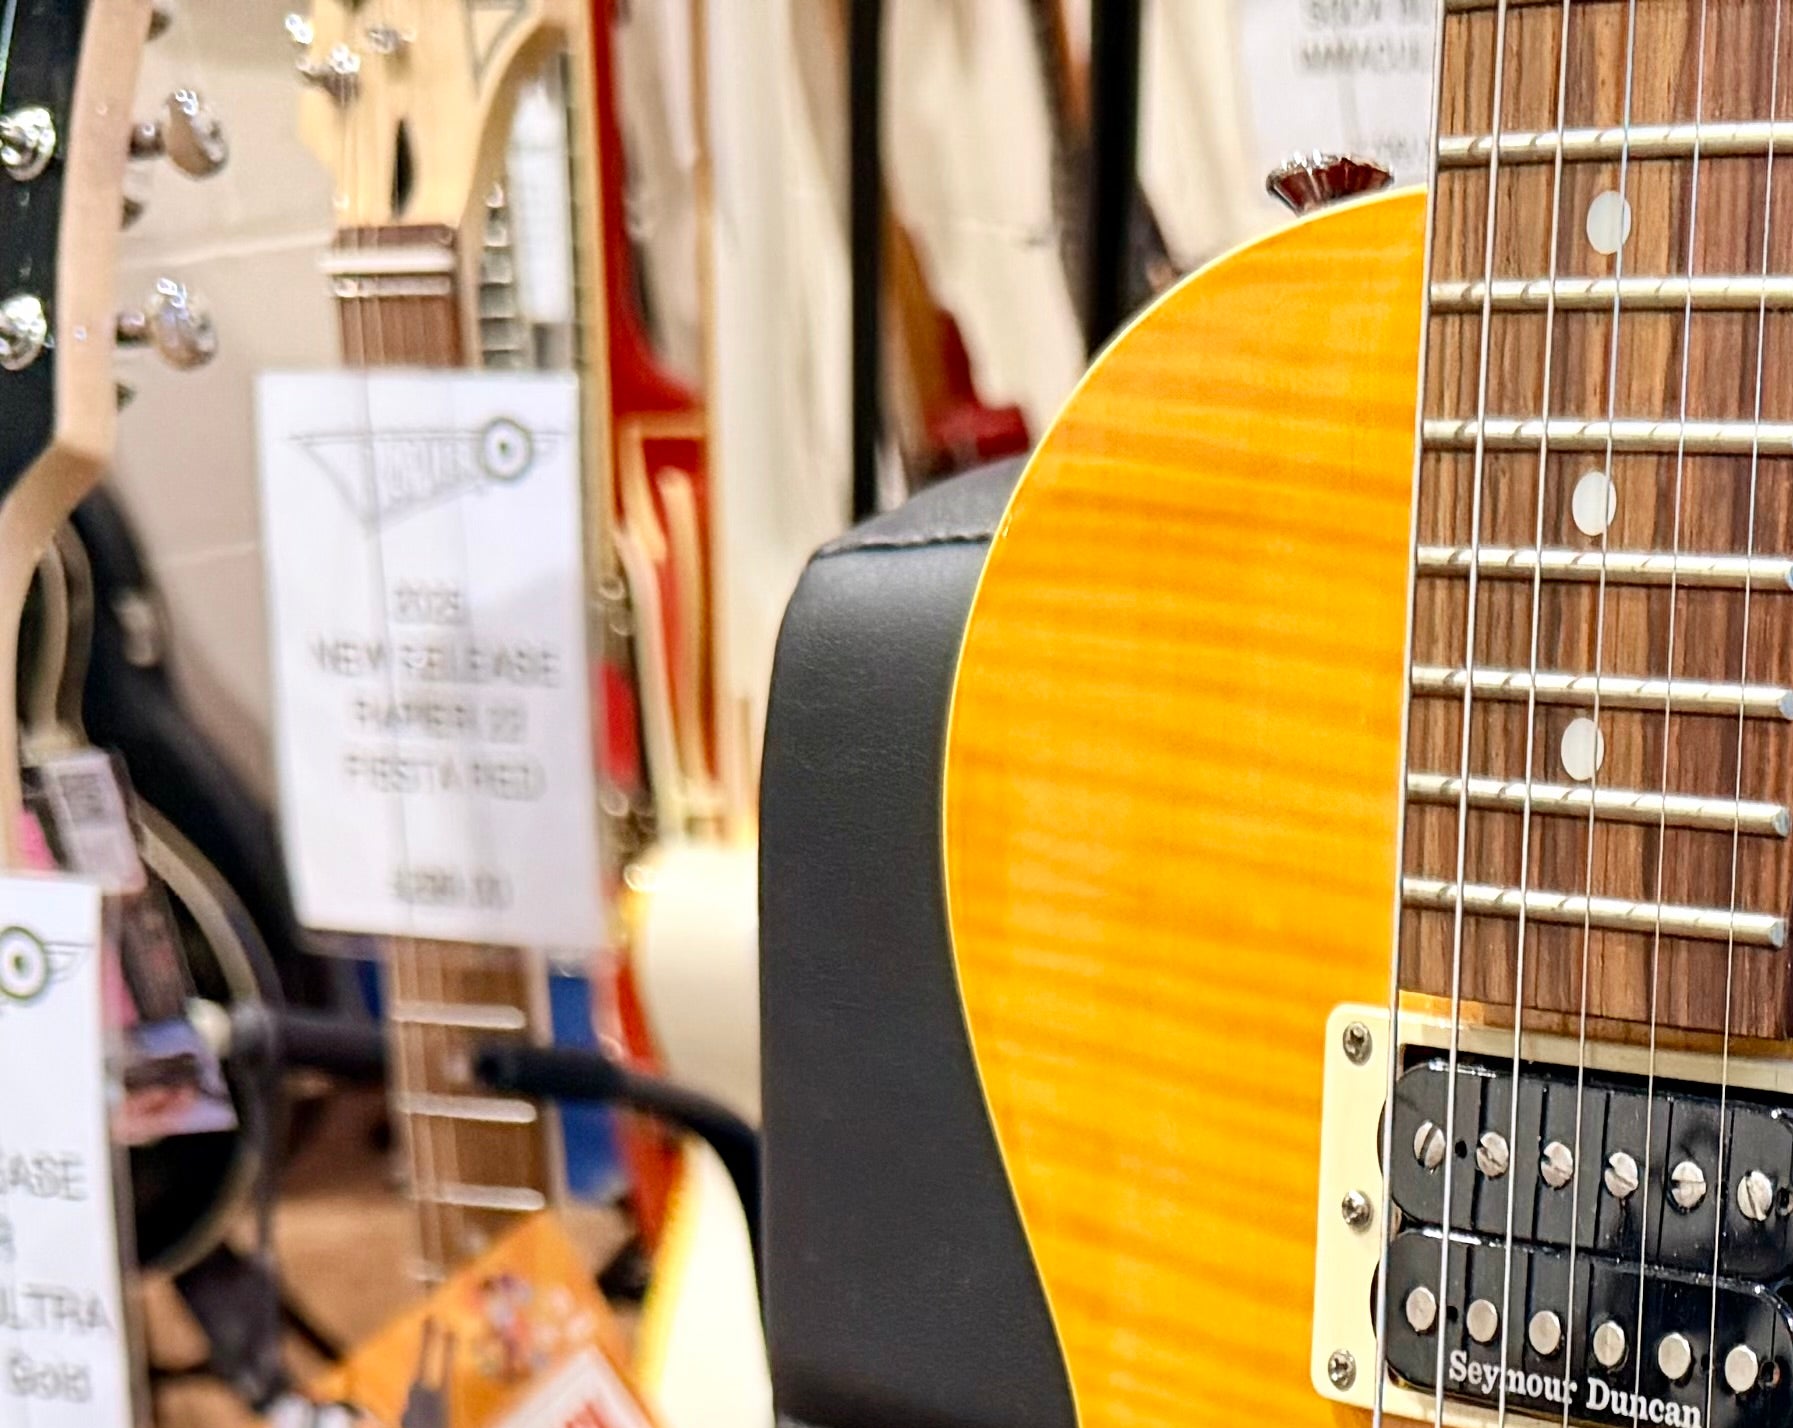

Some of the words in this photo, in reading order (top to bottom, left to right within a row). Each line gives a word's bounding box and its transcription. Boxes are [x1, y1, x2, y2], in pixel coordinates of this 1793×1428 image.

[312, 638, 386, 676] NEW
[398, 640, 560, 688] RELEASE
[1448, 1349, 1578, 1405] Seymour
